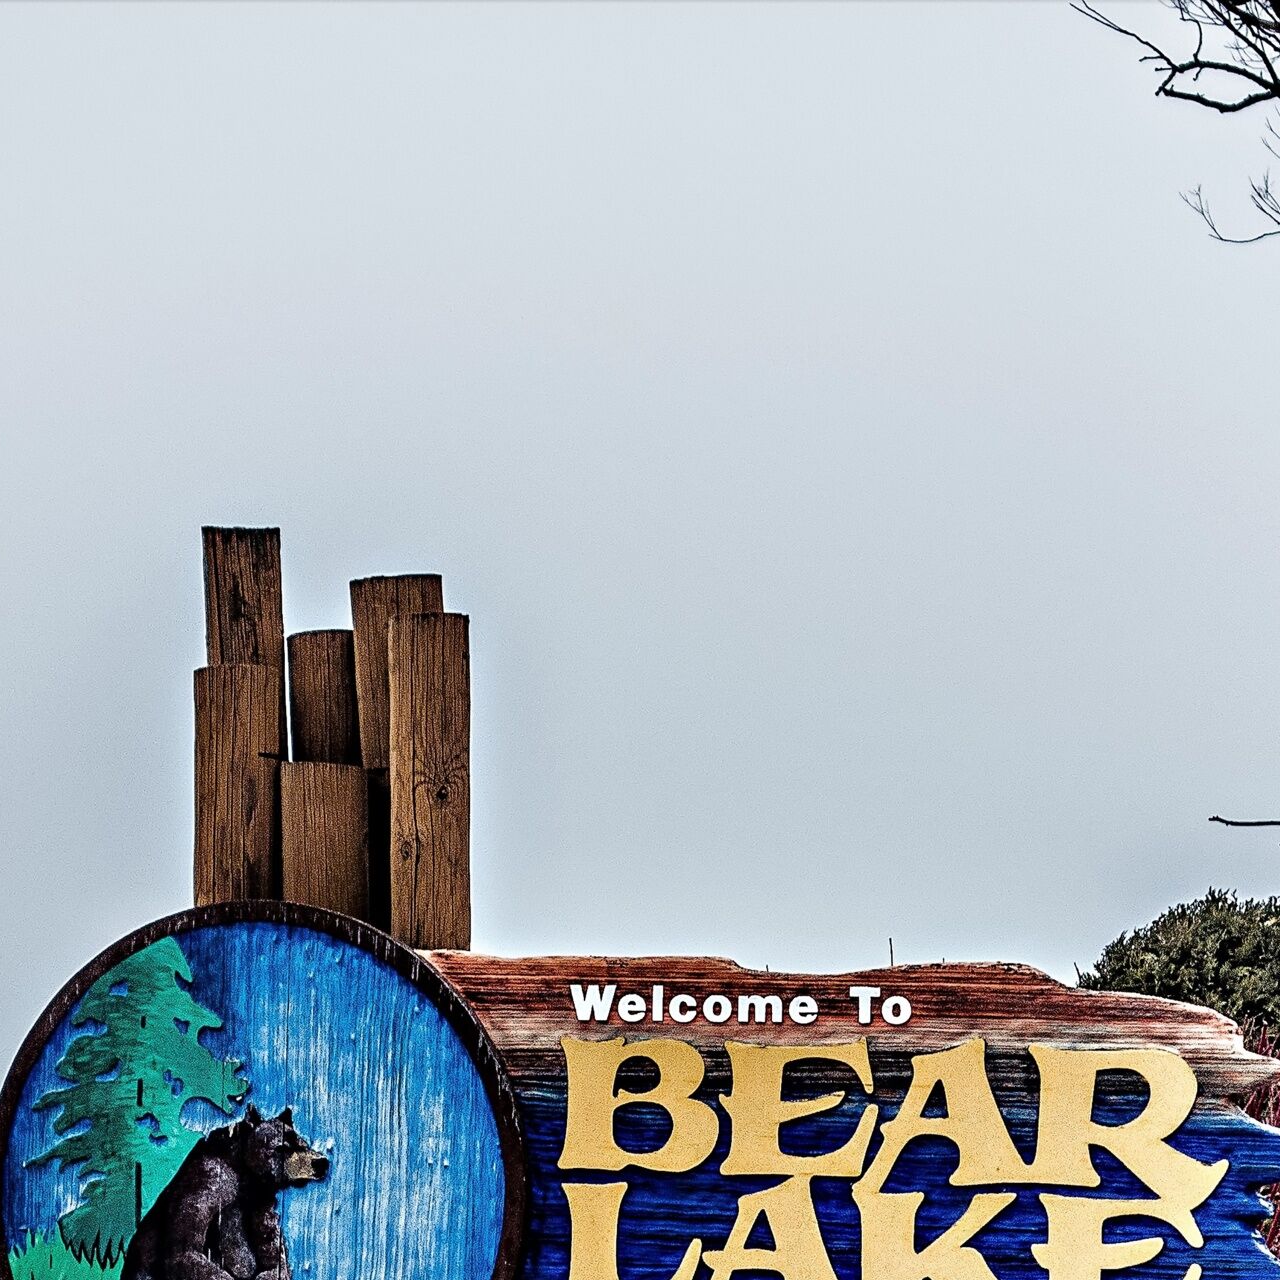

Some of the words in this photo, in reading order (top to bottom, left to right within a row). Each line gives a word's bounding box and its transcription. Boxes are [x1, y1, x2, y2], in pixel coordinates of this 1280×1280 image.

[570, 985, 818, 1023] Welcome
[850, 986, 911, 1024] To
[557, 1036, 1228, 1205] BEAR
